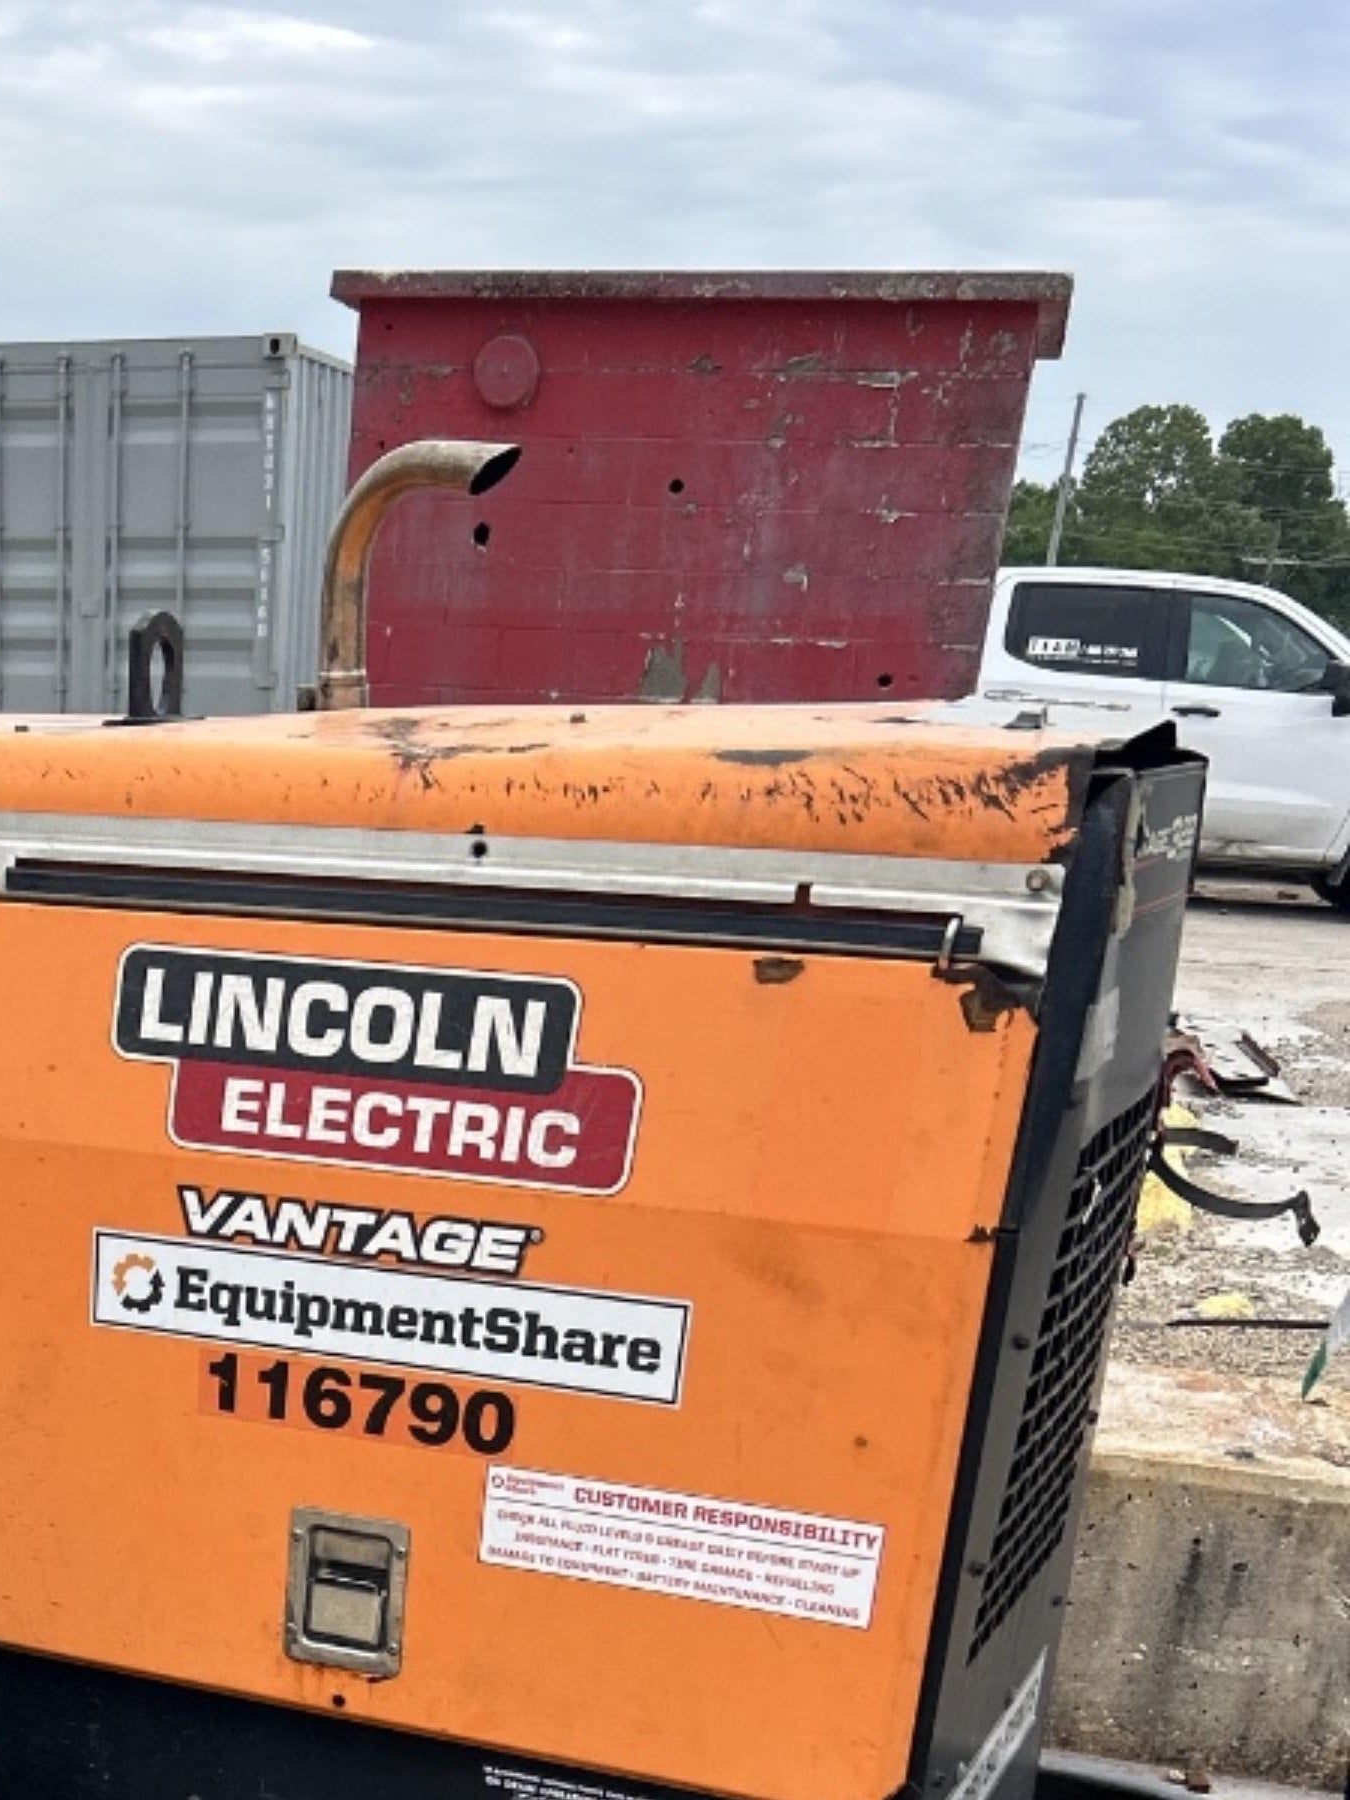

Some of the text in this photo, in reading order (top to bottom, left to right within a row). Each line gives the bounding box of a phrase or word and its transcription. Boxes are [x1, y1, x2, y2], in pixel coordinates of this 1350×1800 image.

[138, 968, 545, 1077] LINCOLN
[220, 1079, 582, 1170] ELECTRIC
[177, 1184, 530, 1274] VANTAGE
[174, 1265, 662, 1376] EquipmentShare
[207, 1353, 516, 1456] 116790
[573, 1486, 880, 1550] CUSTOMER RESPONSIBILITY
